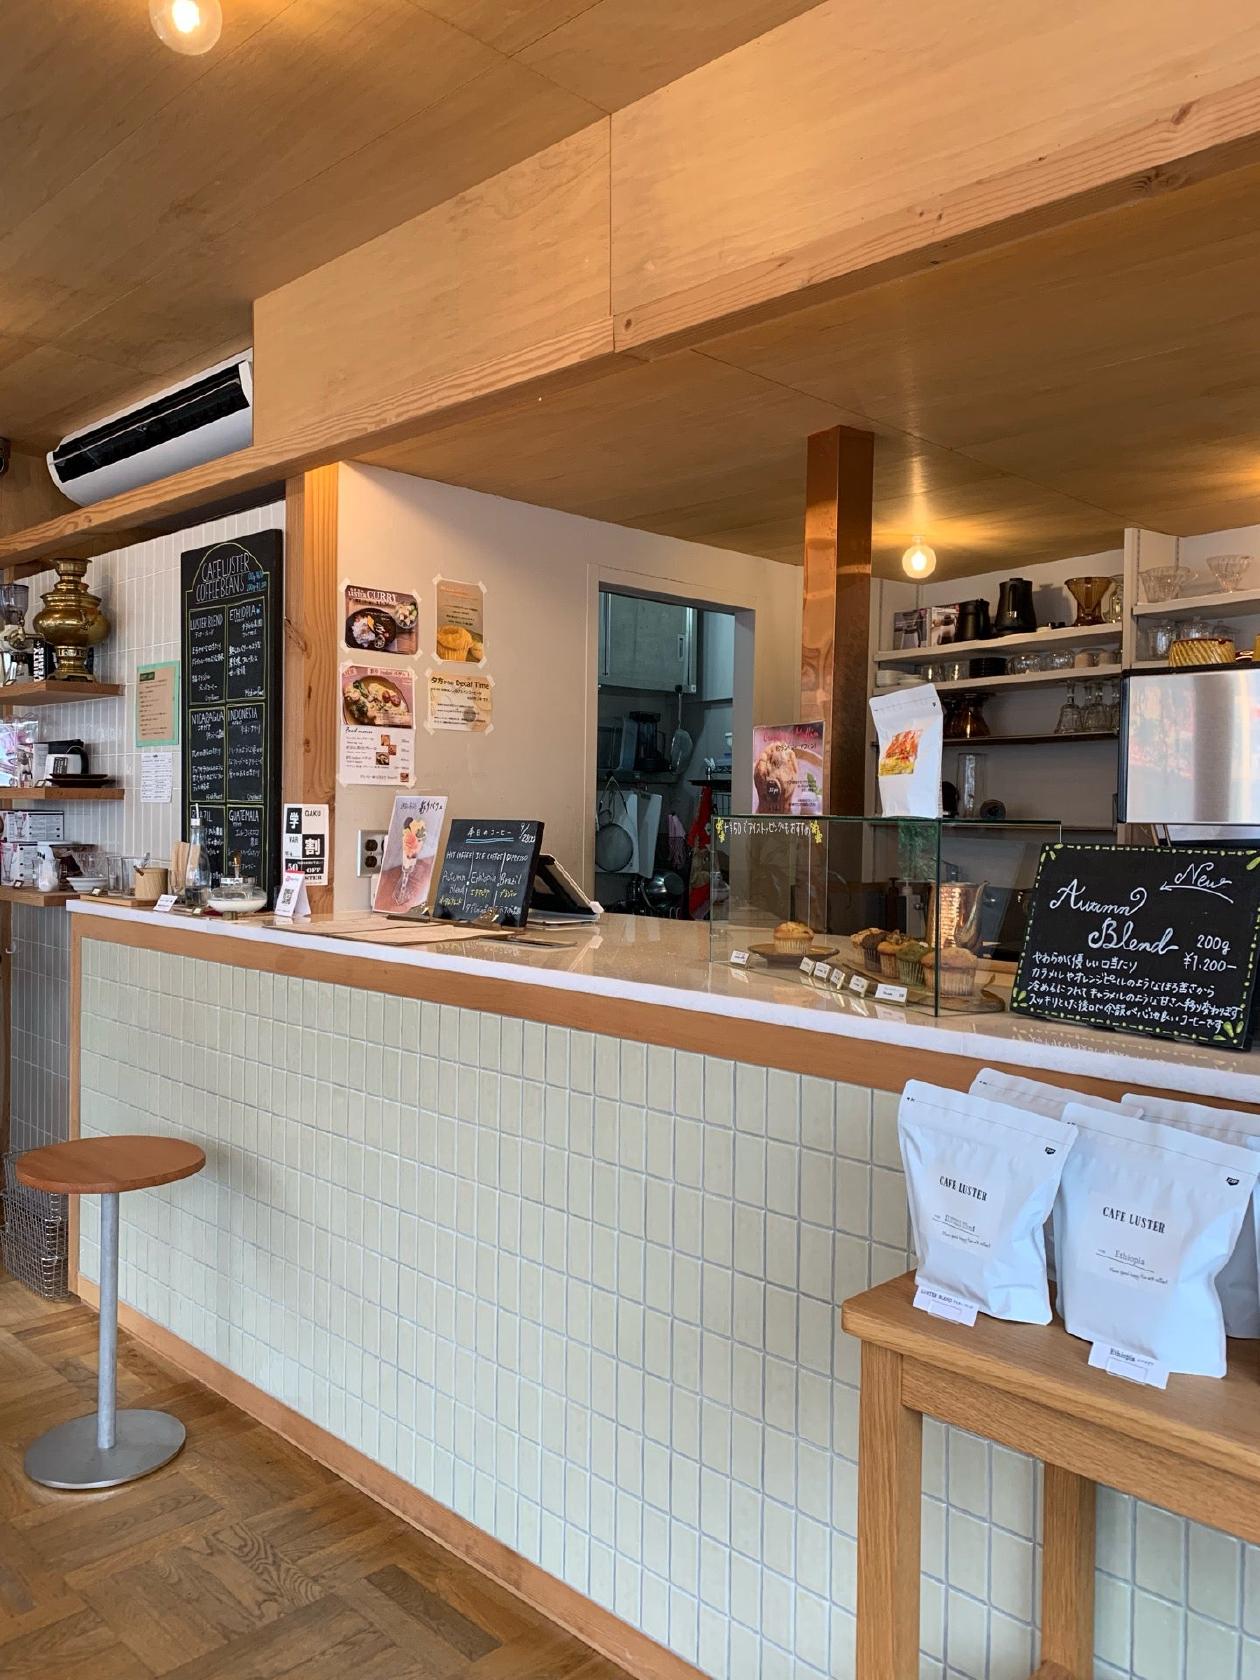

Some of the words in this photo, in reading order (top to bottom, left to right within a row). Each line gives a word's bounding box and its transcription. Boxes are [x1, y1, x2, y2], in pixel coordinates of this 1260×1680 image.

[222, 552, 250, 577] LUSTER
[367, 590, 398, 604] CURRY
[229, 605, 256, 621] ETHIOPIA
[289, 812, 300, 829] 学
[304, 838, 321, 856] 割
[1174, 862, 1233, 889] New
[1050, 878, 1147, 915] Autumn
[1088, 917, 1179, 954] Blend
[1197, 934, 1231, 955] 200g
[939, 1175, 957, 1191] CAFE
[958, 1182, 988, 1201] LUSTER
[1102, 1206, 1126, 1222] CAFE
[1129, 1213, 1166, 1234] LUSTER
